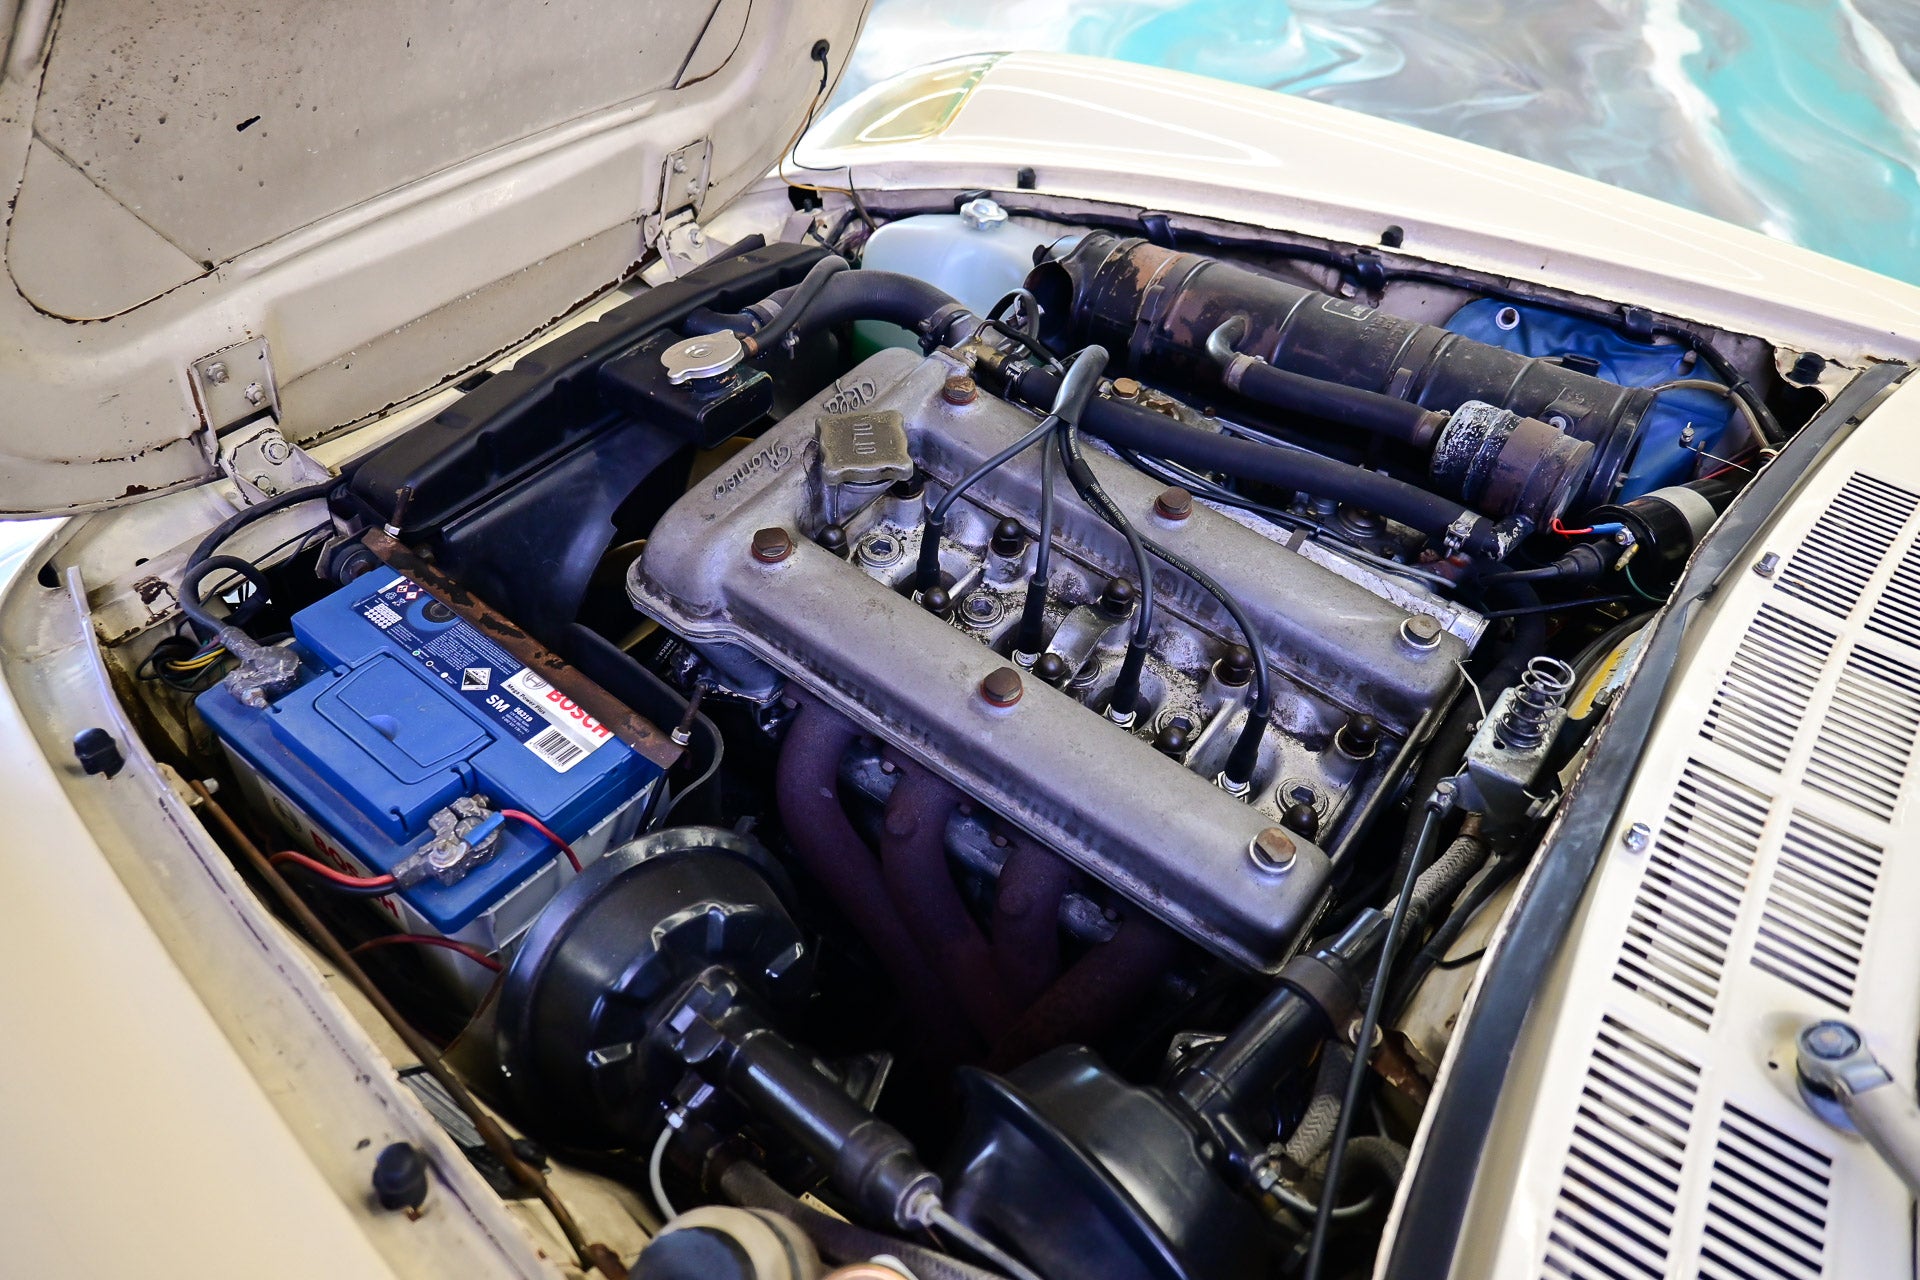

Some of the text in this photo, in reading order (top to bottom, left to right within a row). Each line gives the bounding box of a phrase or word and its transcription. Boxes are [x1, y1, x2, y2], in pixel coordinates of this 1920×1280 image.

[714, 437, 793, 500] Romeo
[485, 694, 511, 713] SM
[507, 683, 546, 715] Mega Power Plus
